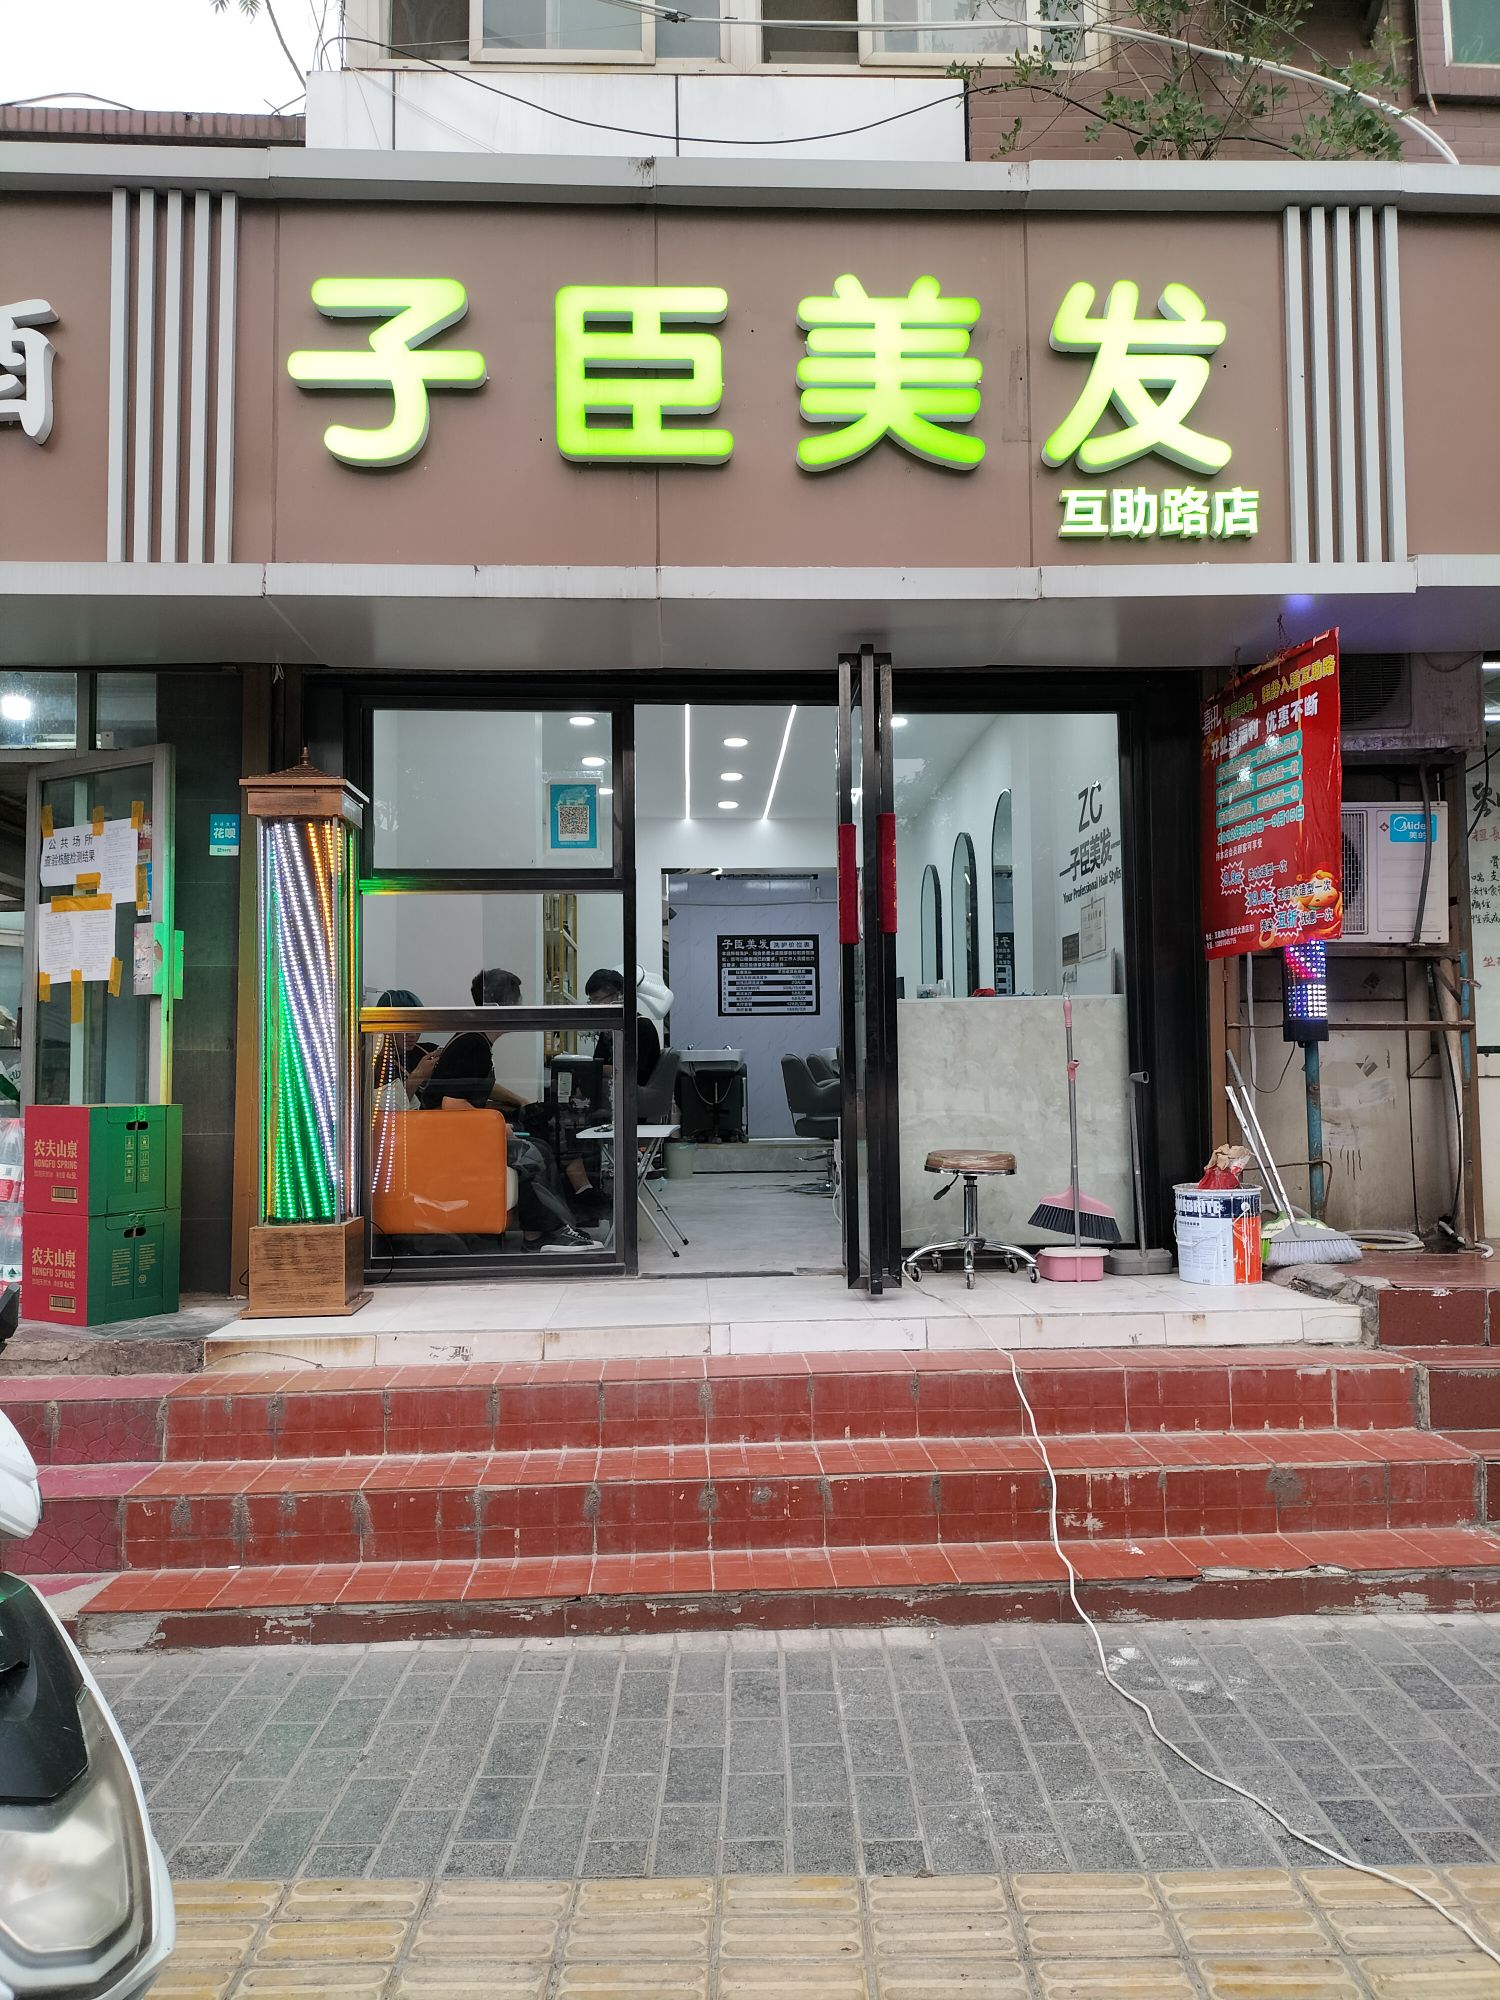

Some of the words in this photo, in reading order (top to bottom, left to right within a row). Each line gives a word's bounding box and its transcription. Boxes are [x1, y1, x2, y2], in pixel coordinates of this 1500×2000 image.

[286, 273, 1234, 474] 子臣美发
[1058, 485, 1260, 541] 互助路店
[1211, 718, 1259, 761] 开业送福利
[1265, 692, 1319, 732] 优惠不断
[1078, 782, 1103, 833] ZC
[48, 833, 93, 850] 公共场所
[213, 827, 236, 839] 花呗
[44, 849, 96, 867] 查验核酸检测结果
[1070, 827, 1112, 881] 子臣美发
[1073, 876, 1098, 900] Professional
[1109, 866, 1122, 885] Stylis
[1277, 878, 1332, 901] 洗剪吹造型一次
[1276, 909, 1299, 929] 五折
[1300, 907, 1334, 926] 优惠一次
[722, 939, 770, 950] 子臣美发
[34, 1138, 78, 1158] 农夫山泉
[33, 1158, 56, 1169] NONGFU
[56, 1159, 78, 1170] SPRING
[31, 1246, 76, 1268] 农夫山泉
[31, 1266, 54, 1277] NONGFU
[54, 1268, 76, 1280] SPRING
